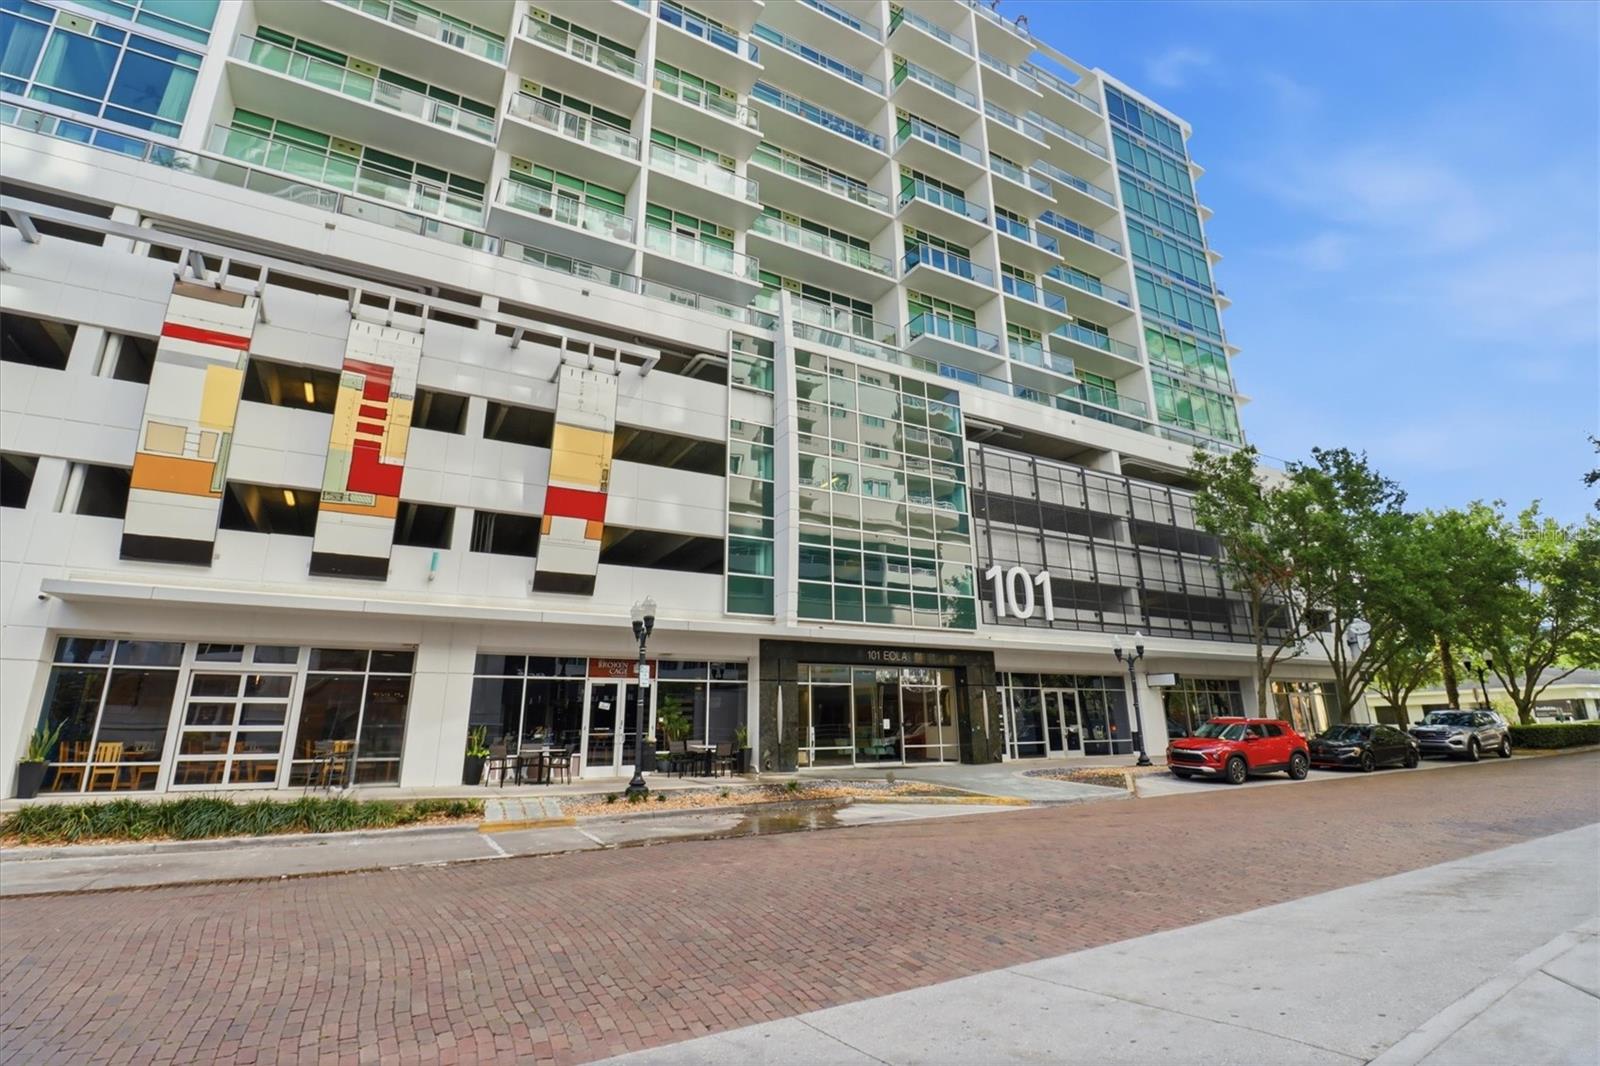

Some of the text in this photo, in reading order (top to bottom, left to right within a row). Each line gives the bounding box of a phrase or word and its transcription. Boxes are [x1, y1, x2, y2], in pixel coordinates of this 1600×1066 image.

[985, 565, 1055, 621] 101
[866, 650, 908, 661] 101 EOLA
